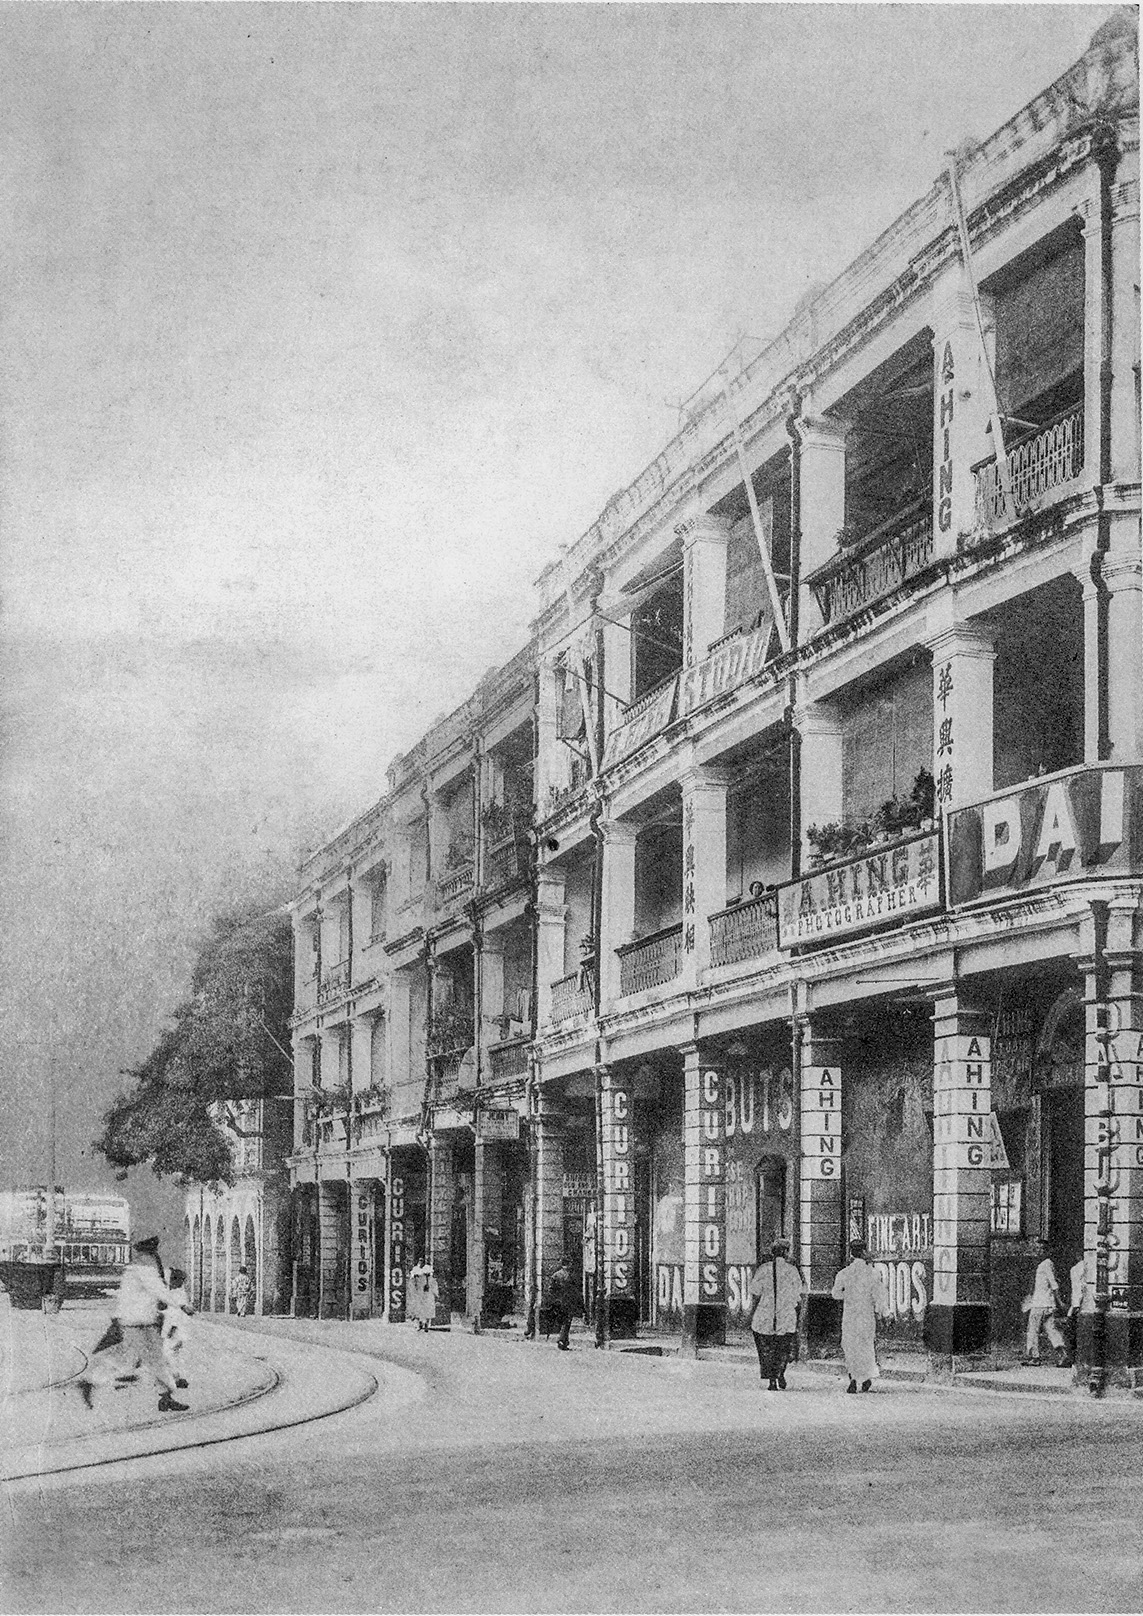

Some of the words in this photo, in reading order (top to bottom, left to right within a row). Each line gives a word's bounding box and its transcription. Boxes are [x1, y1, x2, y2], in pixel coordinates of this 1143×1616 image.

[938, 340, 955, 533] AHING
[797, 885, 918, 937] PHOTOGRAPHER
[819, 1069, 834, 1177] AHING
[966, 1037, 983, 1166] AHING
[358, 1196, 370, 1292] CURIOS
[391, 1178, 404, 1310] CURIOS
[614, 1091, 629, 1289] CURIOS
[703, 1071, 719, 1296] CURIOS
[867, 1214, 896, 1251] FINE
